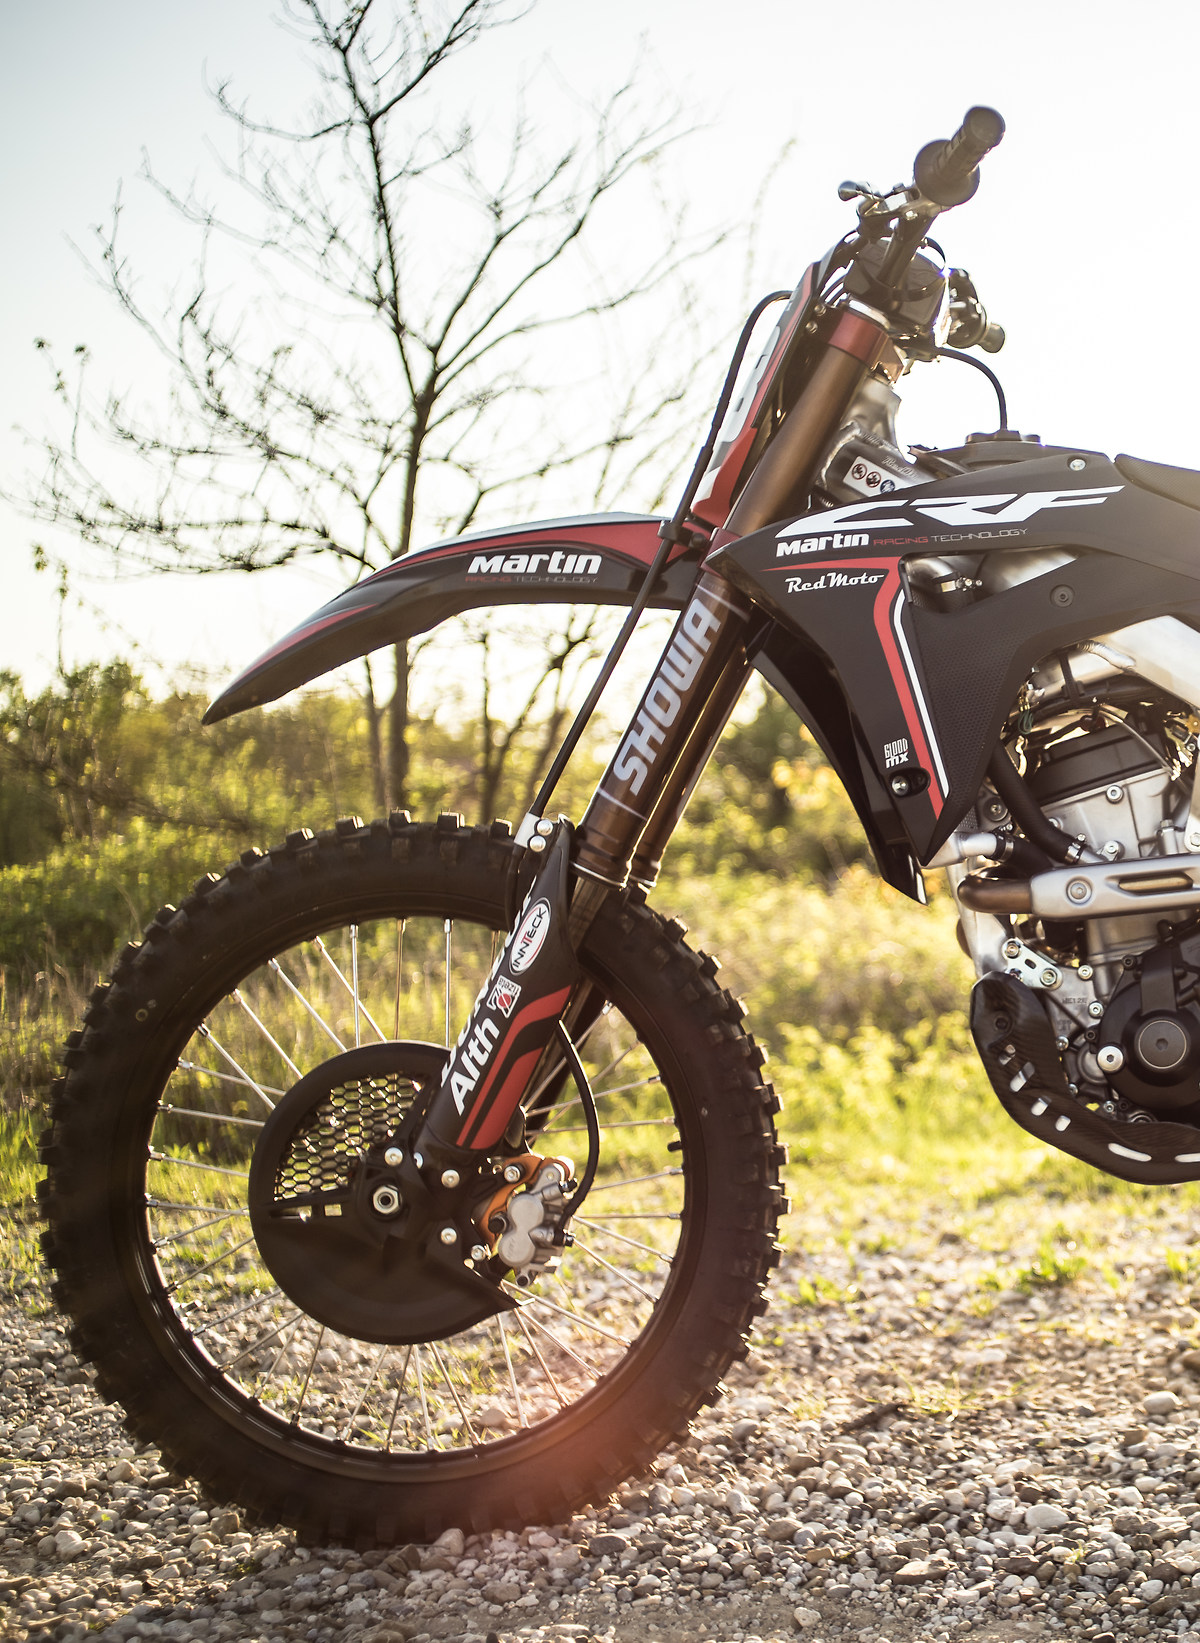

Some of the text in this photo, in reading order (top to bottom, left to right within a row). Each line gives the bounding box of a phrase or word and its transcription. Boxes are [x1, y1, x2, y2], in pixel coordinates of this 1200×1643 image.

[775, 485, 1126, 538] CRF
[467, 551, 602, 574] Martin
[775, 528, 1029, 558] Martin RACING TECHNOLOGY
[613, 598, 722, 796] SHOWA
[512, 907, 547, 969] INNTECK
